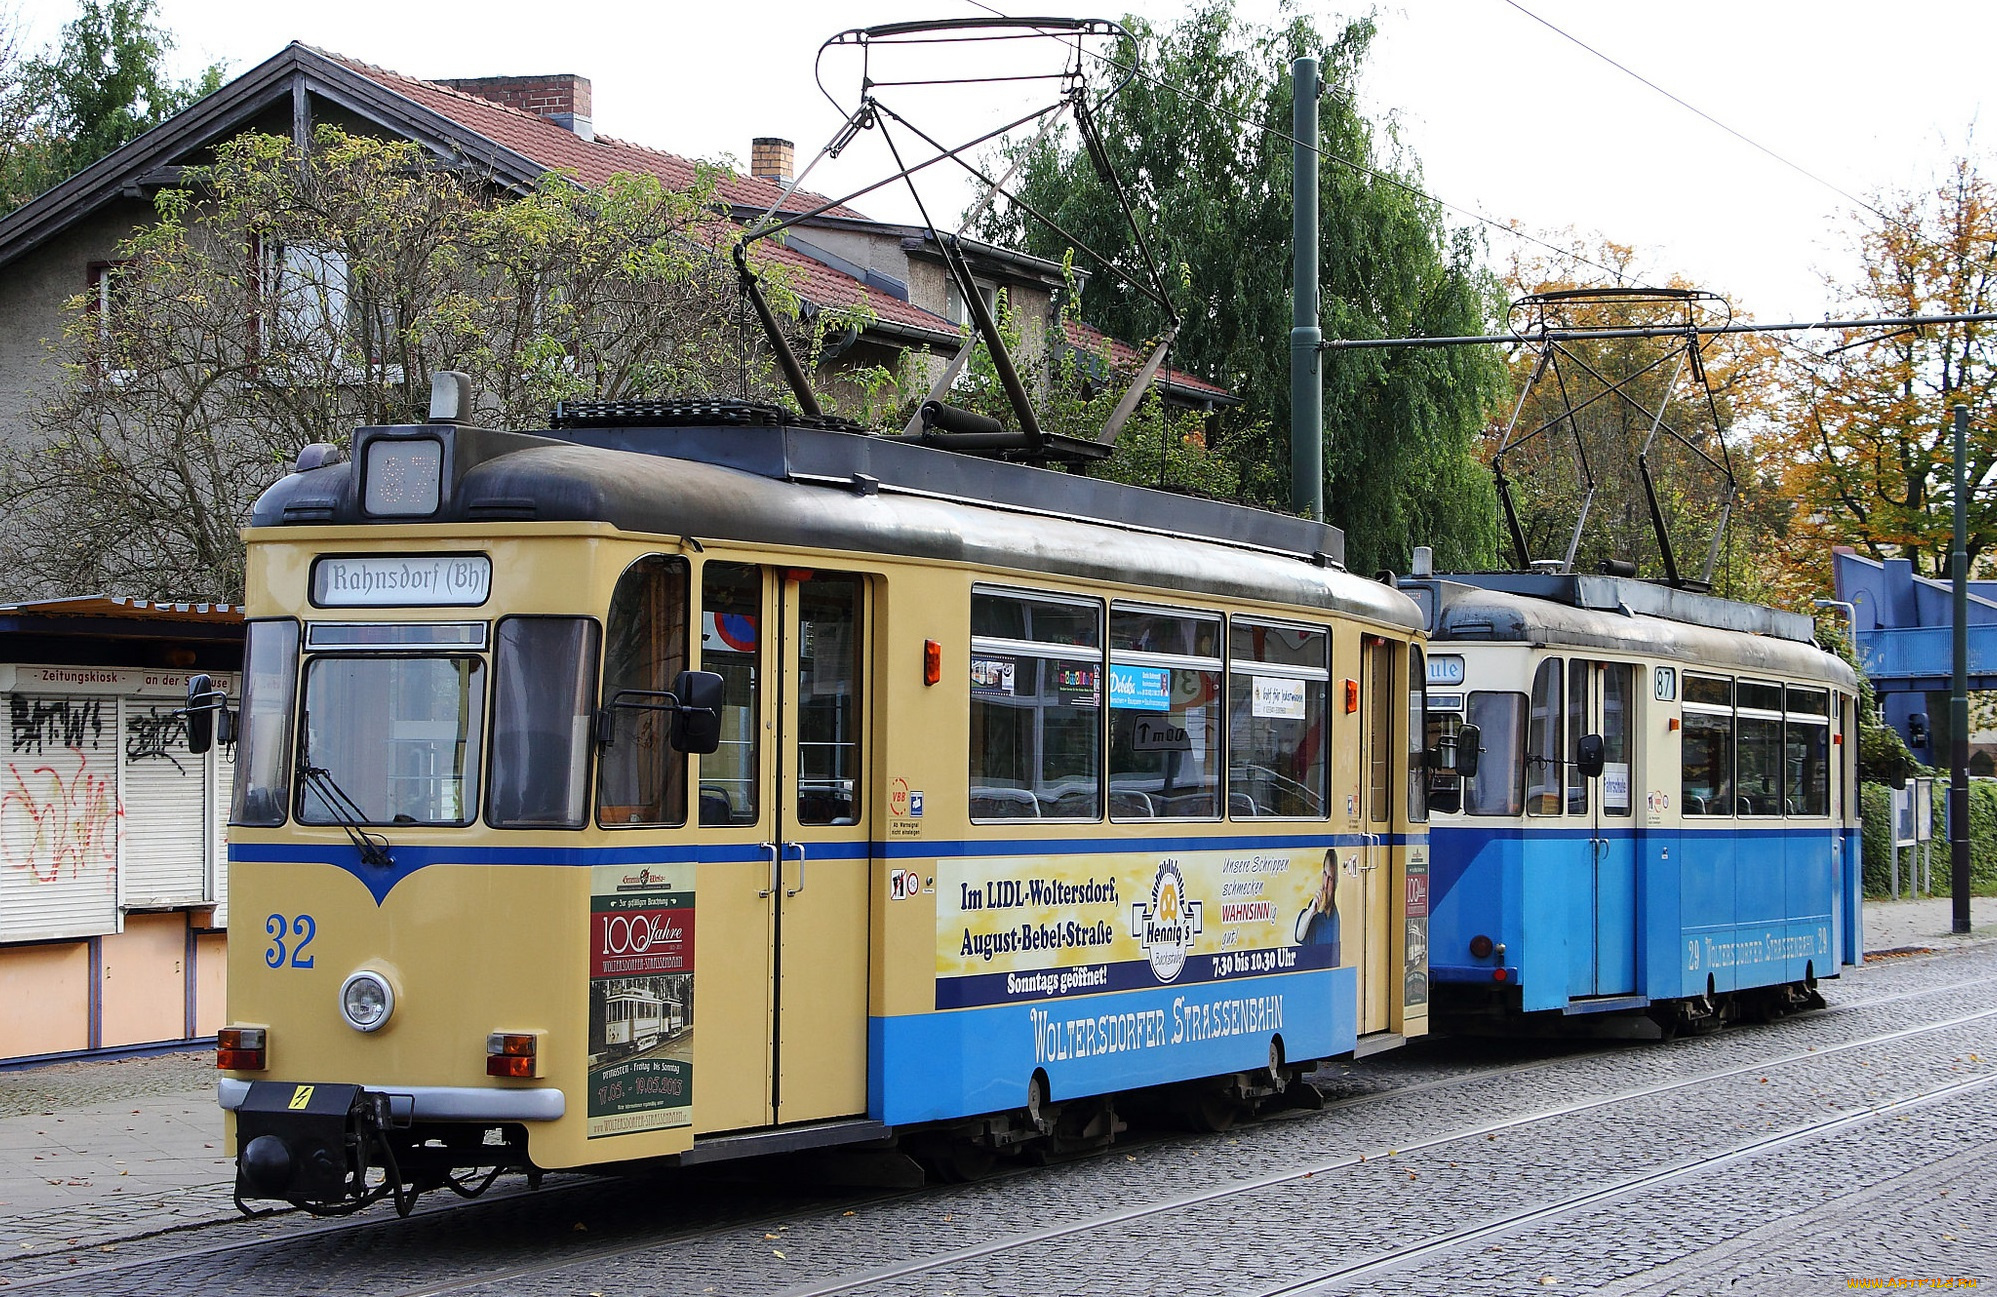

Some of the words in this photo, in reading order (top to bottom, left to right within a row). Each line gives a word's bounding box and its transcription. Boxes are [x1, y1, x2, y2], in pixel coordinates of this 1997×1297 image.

[381, 456, 437, 502] 87
[333, 563, 439, 595] Rahnsdorf
[42, 670, 118, 685] Zeitungskiosk
[146, 677, 158, 686] an
[163, 675, 180, 686] der
[1657, 671, 1670, 697] 87
[893, 792, 906, 802] VBB
[1222, 858, 1250, 874] Unsere
[1252, 856, 1290, 878] Schrippen
[961, 882, 982, 910] Im
[987, 877, 1119, 910] LIDL-Woltersdorf,
[1222, 880, 1264, 896] schmecken
[265, 913, 316, 969] 32
[603, 915, 650, 954] 100
[649, 914, 682, 942] Jahre
[960, 920, 1112, 960] August-Bebel-Straße
[1221, 928, 1239, 950] gut!
[1688, 939, 1700, 971] 29
[1818, 927, 1828, 954] 29
[1213, 955, 1232, 978] 7.30
[1234, 952, 1250, 972] bis
[1251, 951, 1275, 972] 10.30
[1277, 948, 1296, 968] Uhr
[1007, 973, 1059, 995] Sonntags
[1060, 965, 1108, 993] geöffnet!
[1030, 1007, 1165, 1063] WOLTERSDORFER
[1171, 996, 1283, 1045] STRASSENBAHN
[634, 1062, 650, 1072] Freitag
[653, 1061, 661, 1071] bis
[661, 1062, 680, 1074] Sonntag
